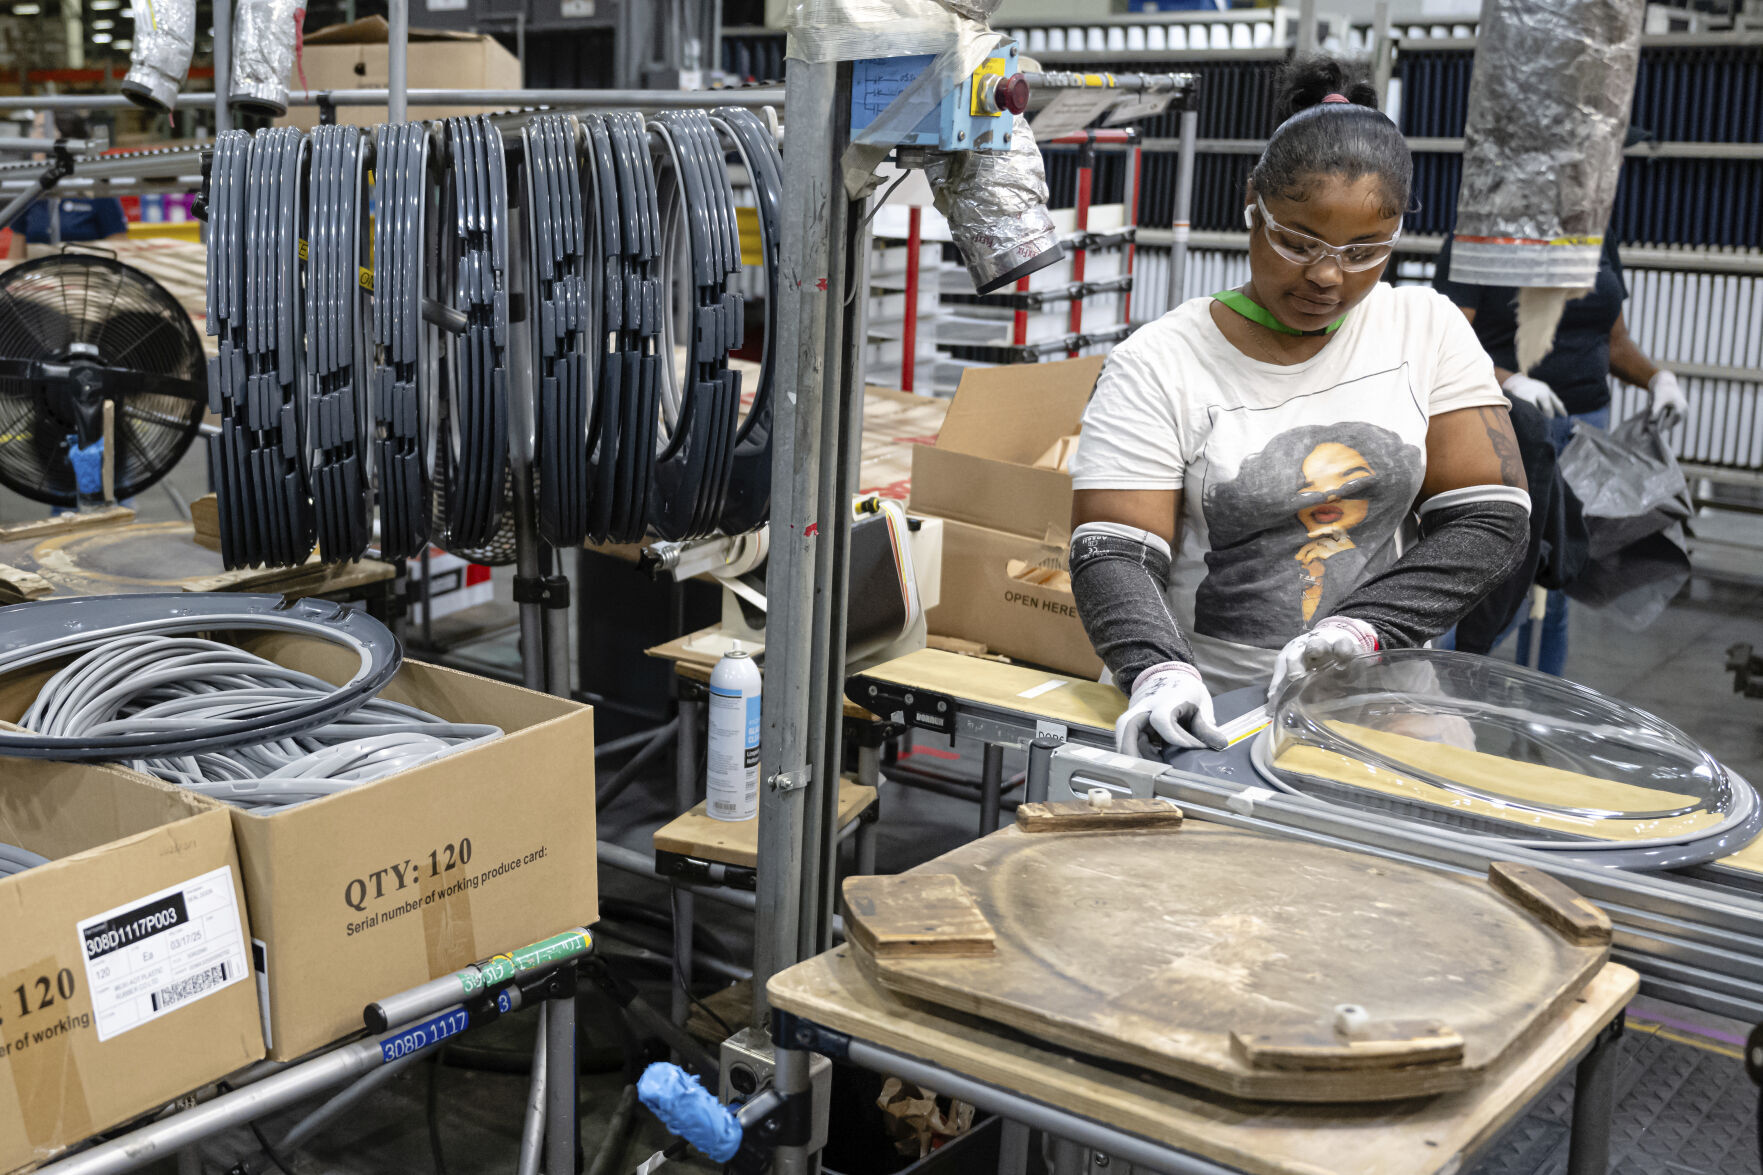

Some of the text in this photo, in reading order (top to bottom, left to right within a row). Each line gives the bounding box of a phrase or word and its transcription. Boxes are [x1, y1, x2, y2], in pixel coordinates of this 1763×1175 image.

[1004, 590, 1076, 618] OPEN HERE
[344, 838, 472, 912] QTY: 120
[346, 846, 548, 936] Serial number of working produce card:
[86, 907, 178, 956] 308D1117P003
[170, 931, 202, 950] 03/17/25
[95, 966, 111, 980] 120
[143, 951, 154, 962] Ea
[13, 968, 75, 1018] 120
[15, 1032, 29, 1051] of
[32, 1012, 90, 1044] working
[384, 1011, 466, 1062] 308D 1117
